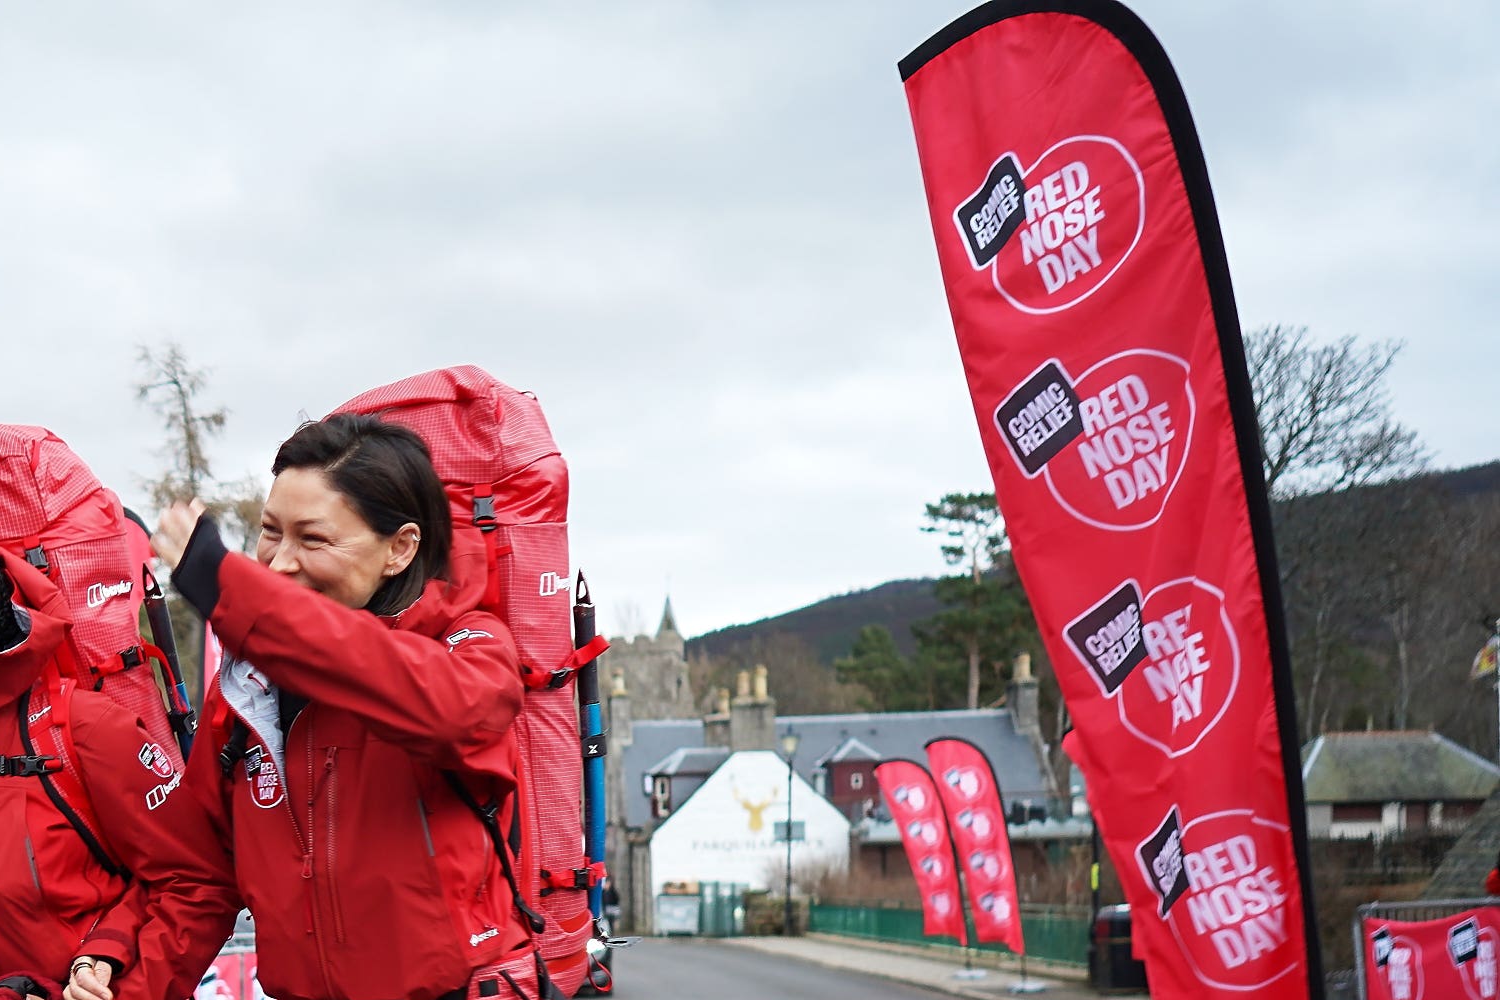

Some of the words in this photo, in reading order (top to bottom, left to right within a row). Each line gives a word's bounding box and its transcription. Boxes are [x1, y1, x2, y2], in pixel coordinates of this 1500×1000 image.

[969, 174, 1016, 233] COMIC
[975, 189, 1020, 250] RELIEF
[1023, 161, 1089, 225] RED
[1019, 185, 1106, 265] NOSE
[1036, 225, 1102, 295] DAY
[1008, 382, 1066, 439] COMIC
[1016, 397, 1074, 457] RELIEF
[1078, 374, 1149, 438] RED
[1077, 401, 1176, 480] NOSE
[1103, 443, 1169, 510] DAY
[1171, 675, 1204, 735] AY
[257, 774, 278, 788] NOSE
[259, 787, 276, 800] DAY
[1183, 834, 1257, 893] RED
[1186, 865, 1289, 936] NOSE
[1210, 906, 1288, 970] DAY
